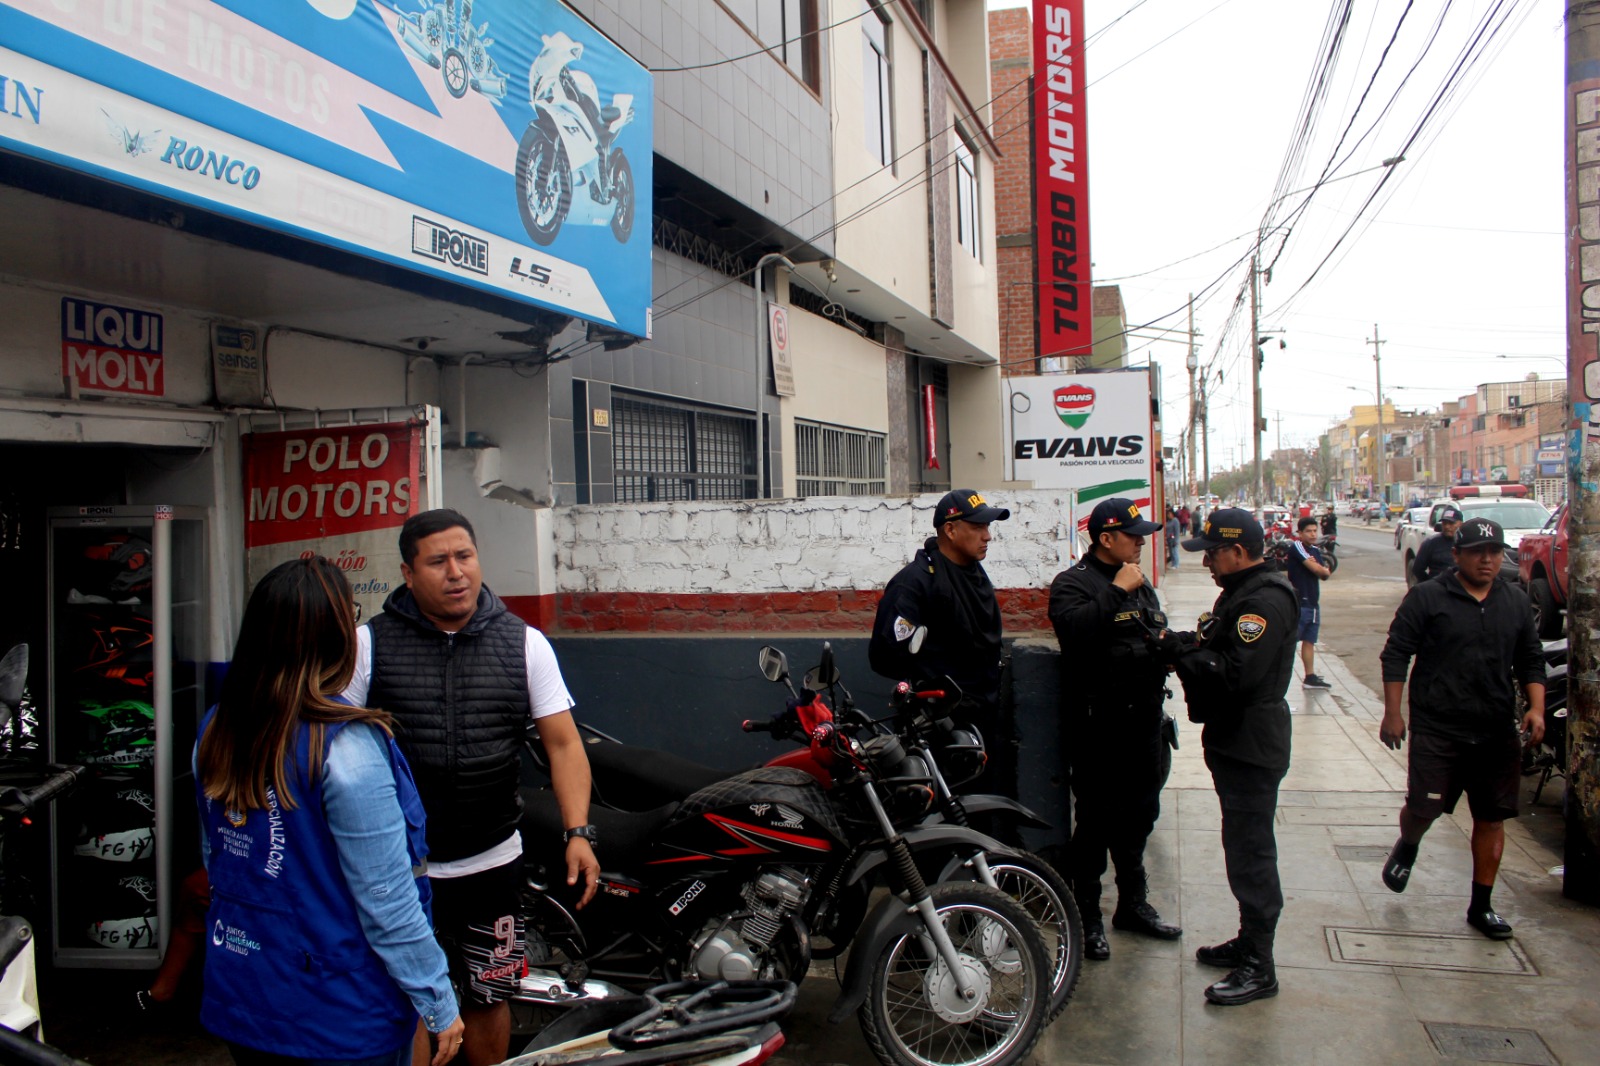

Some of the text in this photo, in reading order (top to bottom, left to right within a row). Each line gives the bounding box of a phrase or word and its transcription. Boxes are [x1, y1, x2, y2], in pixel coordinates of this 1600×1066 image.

[187, 9, 331, 126] MOTOS
[1045, 3, 1076, 184] MOTORS
[159, 135, 262, 190] RONCO
[430, 225, 488, 275] IPONE
[1051, 190, 1080, 335] TURBO
[508, 272, 573, 298] HELMETS
[66, 301, 160, 352] LIQUI
[66, 346, 162, 393] MOLY
[217, 352, 257, 370] seinsa
[1056, 393, 1093, 403] EVANS
[282, 432, 390, 473] POLO
[1014, 435, 1144, 460] EVANS
[1060, 458, 1084, 467] PASIÓN
[1084, 459, 1098, 467] POR
[1108, 458, 1145, 467] VELOCIDAD
[86, 506, 114, 515] IPONE
[248, 476, 412, 522] MOTORS
[769, 820, 804, 831] HONDA
[676, 879, 706, 909] IPONE
